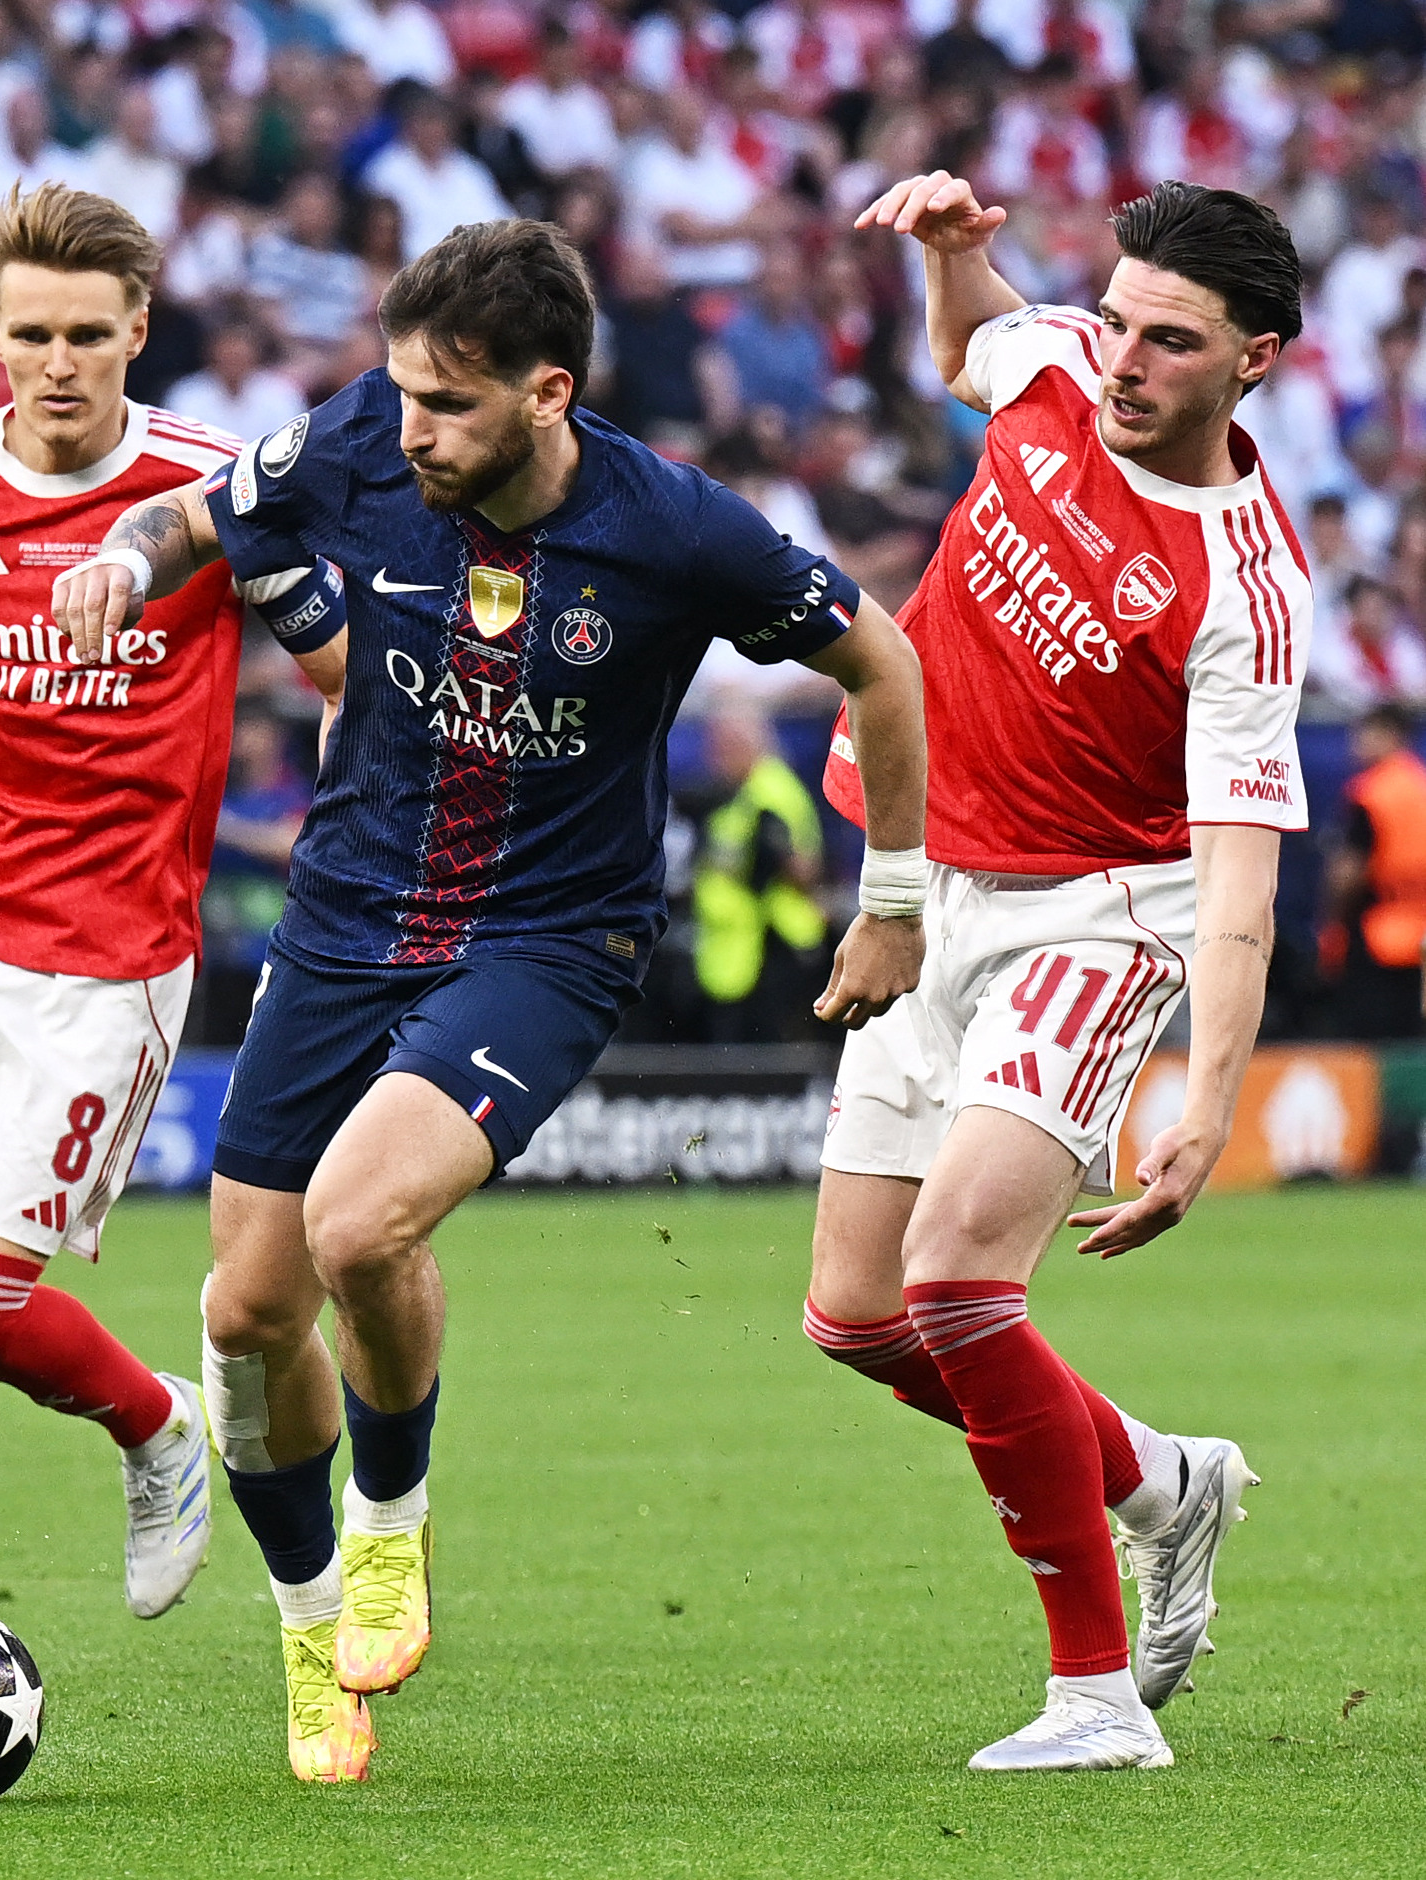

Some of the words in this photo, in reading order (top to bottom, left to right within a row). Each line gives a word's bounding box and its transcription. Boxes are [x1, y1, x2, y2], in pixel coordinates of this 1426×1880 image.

[1068, 501, 1105, 540] BUDAPEST
[738, 568, 828, 645] BEYOND
[969, 477, 1124, 674] Emirates
[1136, 563, 1169, 598] Arsenal
[564, 611, 604, 627] PARIS
[963, 549, 1008, 603] FLY
[994, 589, 1078, 687] BETTER
[30, 667, 133, 707] BETTER
[386, 648, 587, 732] QATAR
[427, 708, 587, 758] AIRWAYS
[1255, 757, 1290, 782] VISIT
[1008, 951, 1113, 1053] 41
[51, 1091, 107, 1184] 8
